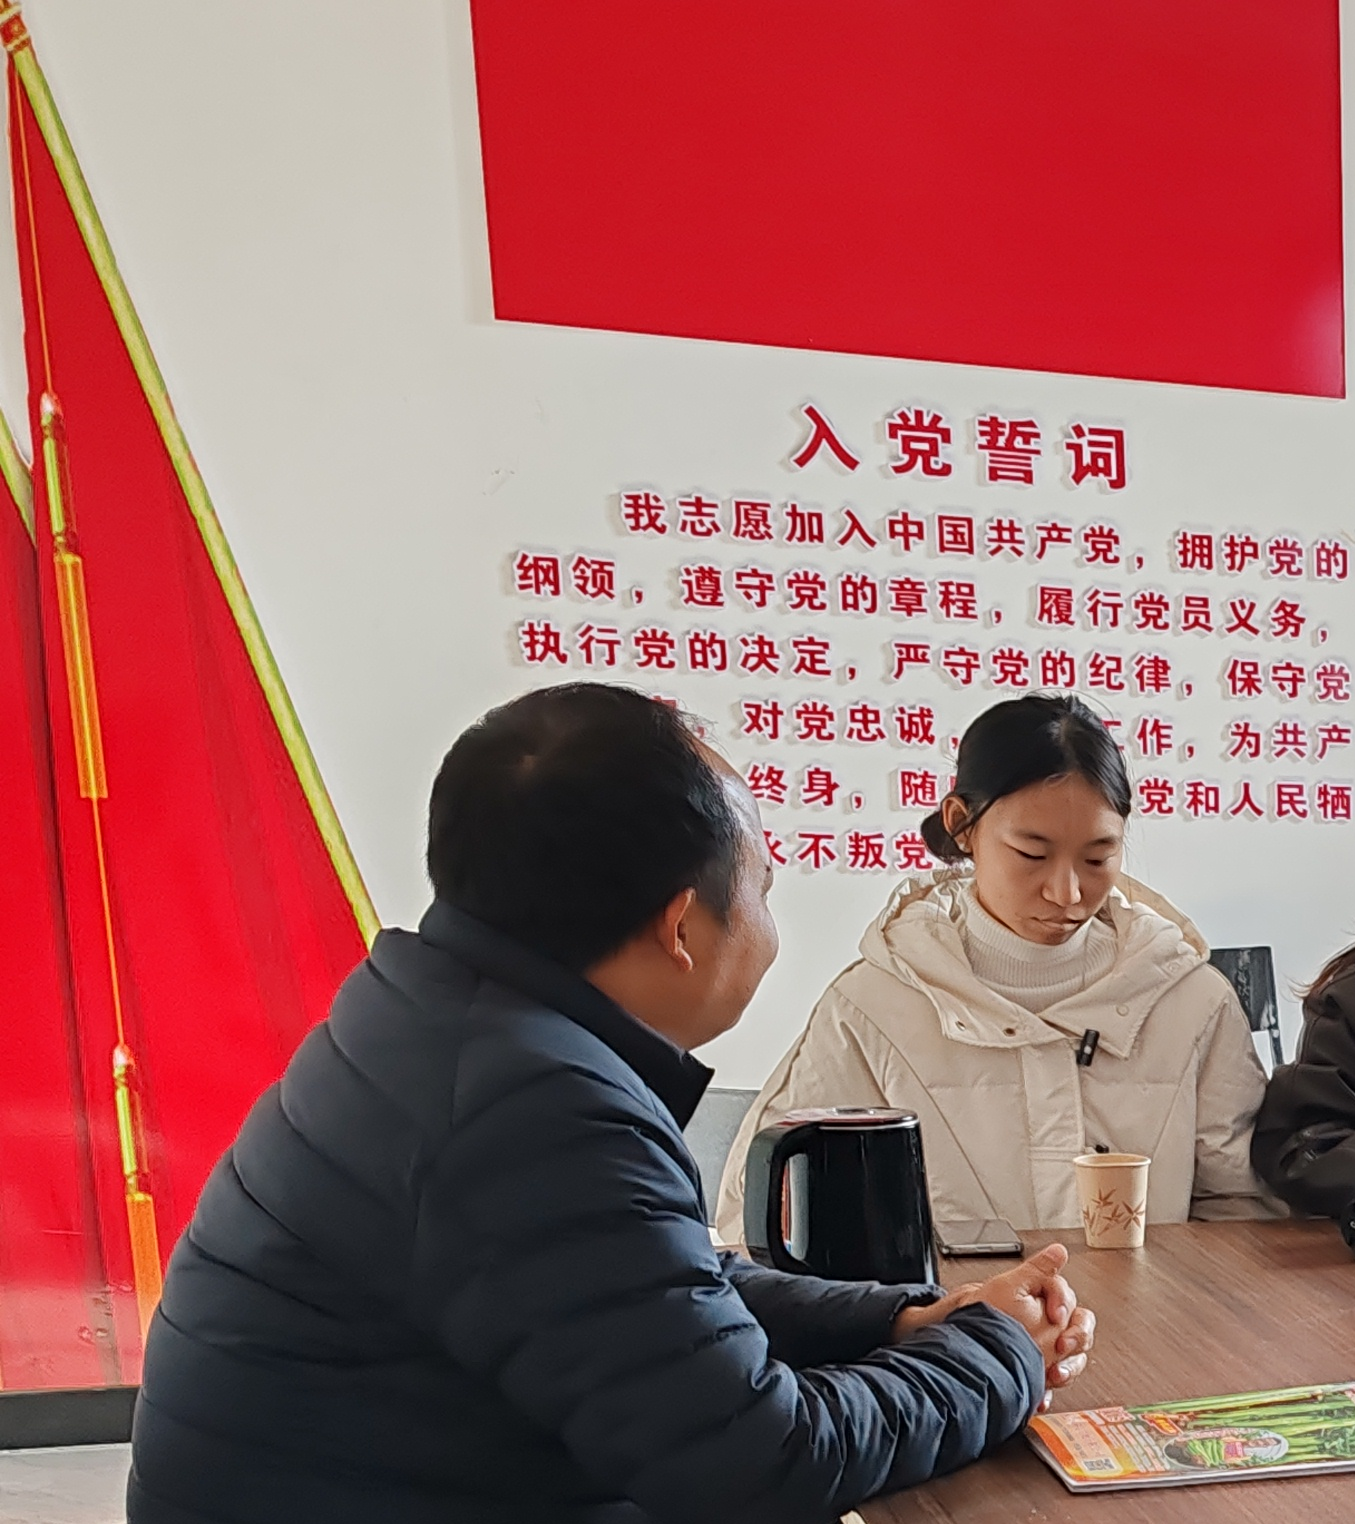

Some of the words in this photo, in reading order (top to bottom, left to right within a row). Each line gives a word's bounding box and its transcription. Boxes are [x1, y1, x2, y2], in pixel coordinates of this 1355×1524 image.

[793, 404, 1128, 491] 入党誓词
[623, 491, 1349, 581] 我志愿加入中国共产党，拥护党的
[515, 552, 1328, 641] 纲领，遵守党的章程，履行党员义务，
[521, 621, 1351, 702] 执行党的决定，严守党的纪律，保守党
